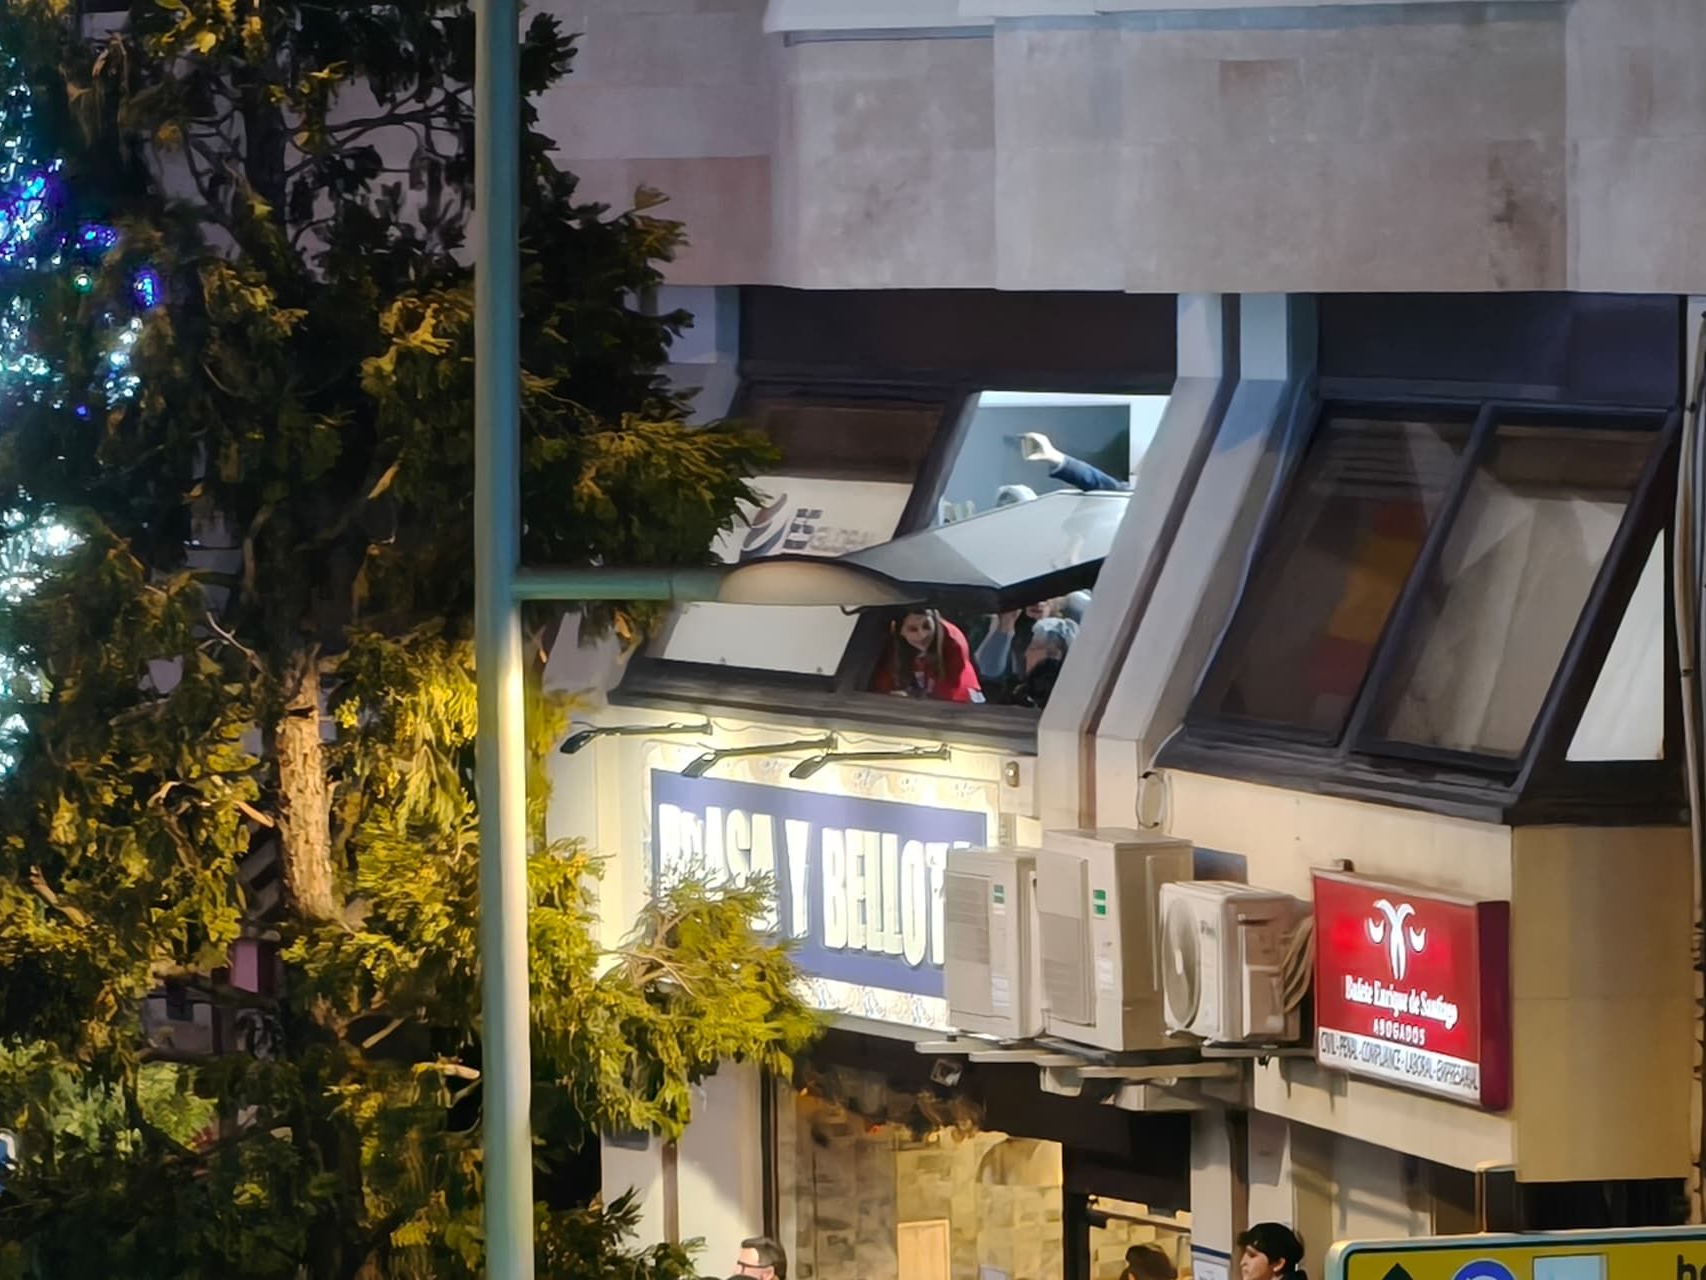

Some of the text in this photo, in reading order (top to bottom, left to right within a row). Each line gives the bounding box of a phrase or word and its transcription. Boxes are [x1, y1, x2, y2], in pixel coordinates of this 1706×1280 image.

[784, 817, 812, 939] Y
[821, 826, 972, 966] BELLOT
[1373, 1018, 1425, 1046] ABOGADOS
